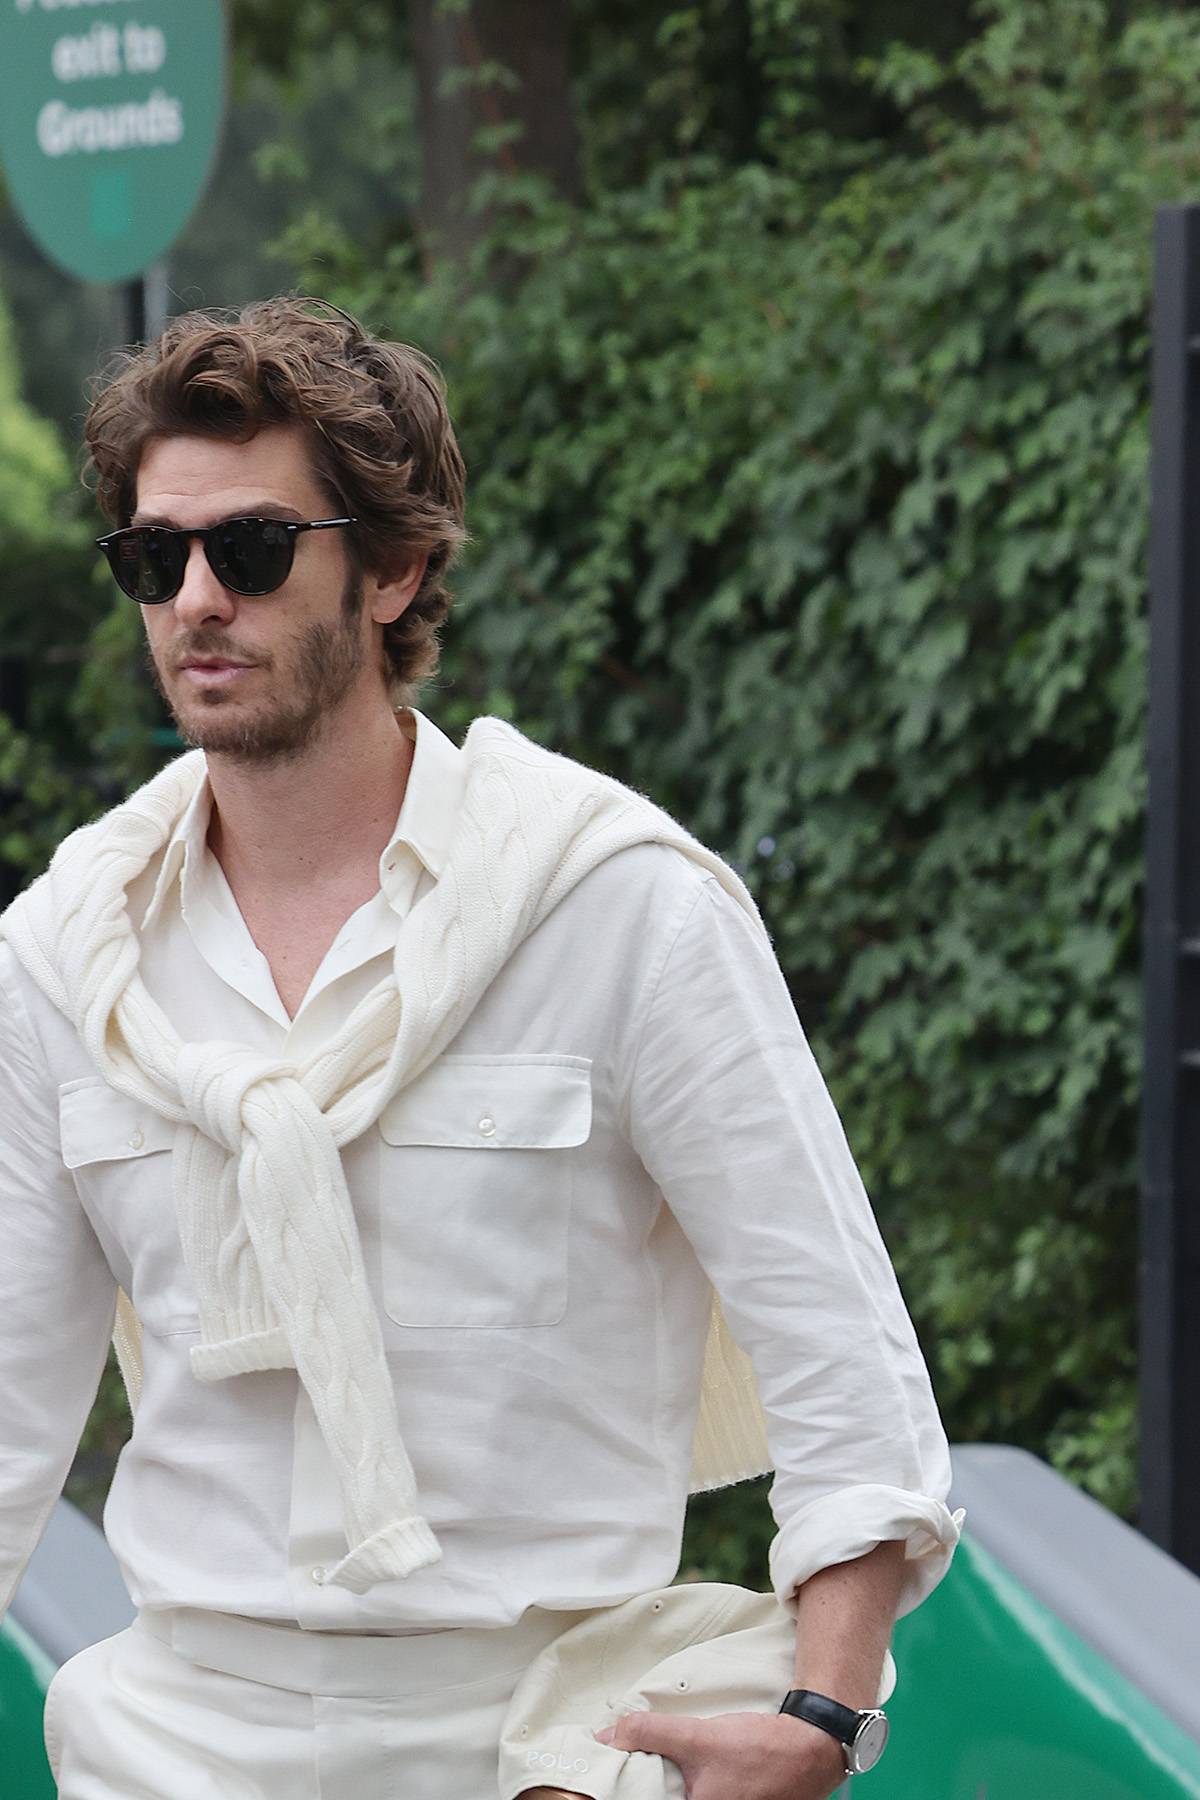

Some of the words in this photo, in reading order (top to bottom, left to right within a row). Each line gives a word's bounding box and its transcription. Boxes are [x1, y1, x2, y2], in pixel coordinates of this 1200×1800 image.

[52, 22, 121, 81] exit
[123, 20, 166, 74] to
[36, 87, 184, 157] Grounds
[526, 1751, 589, 1774] POLO
